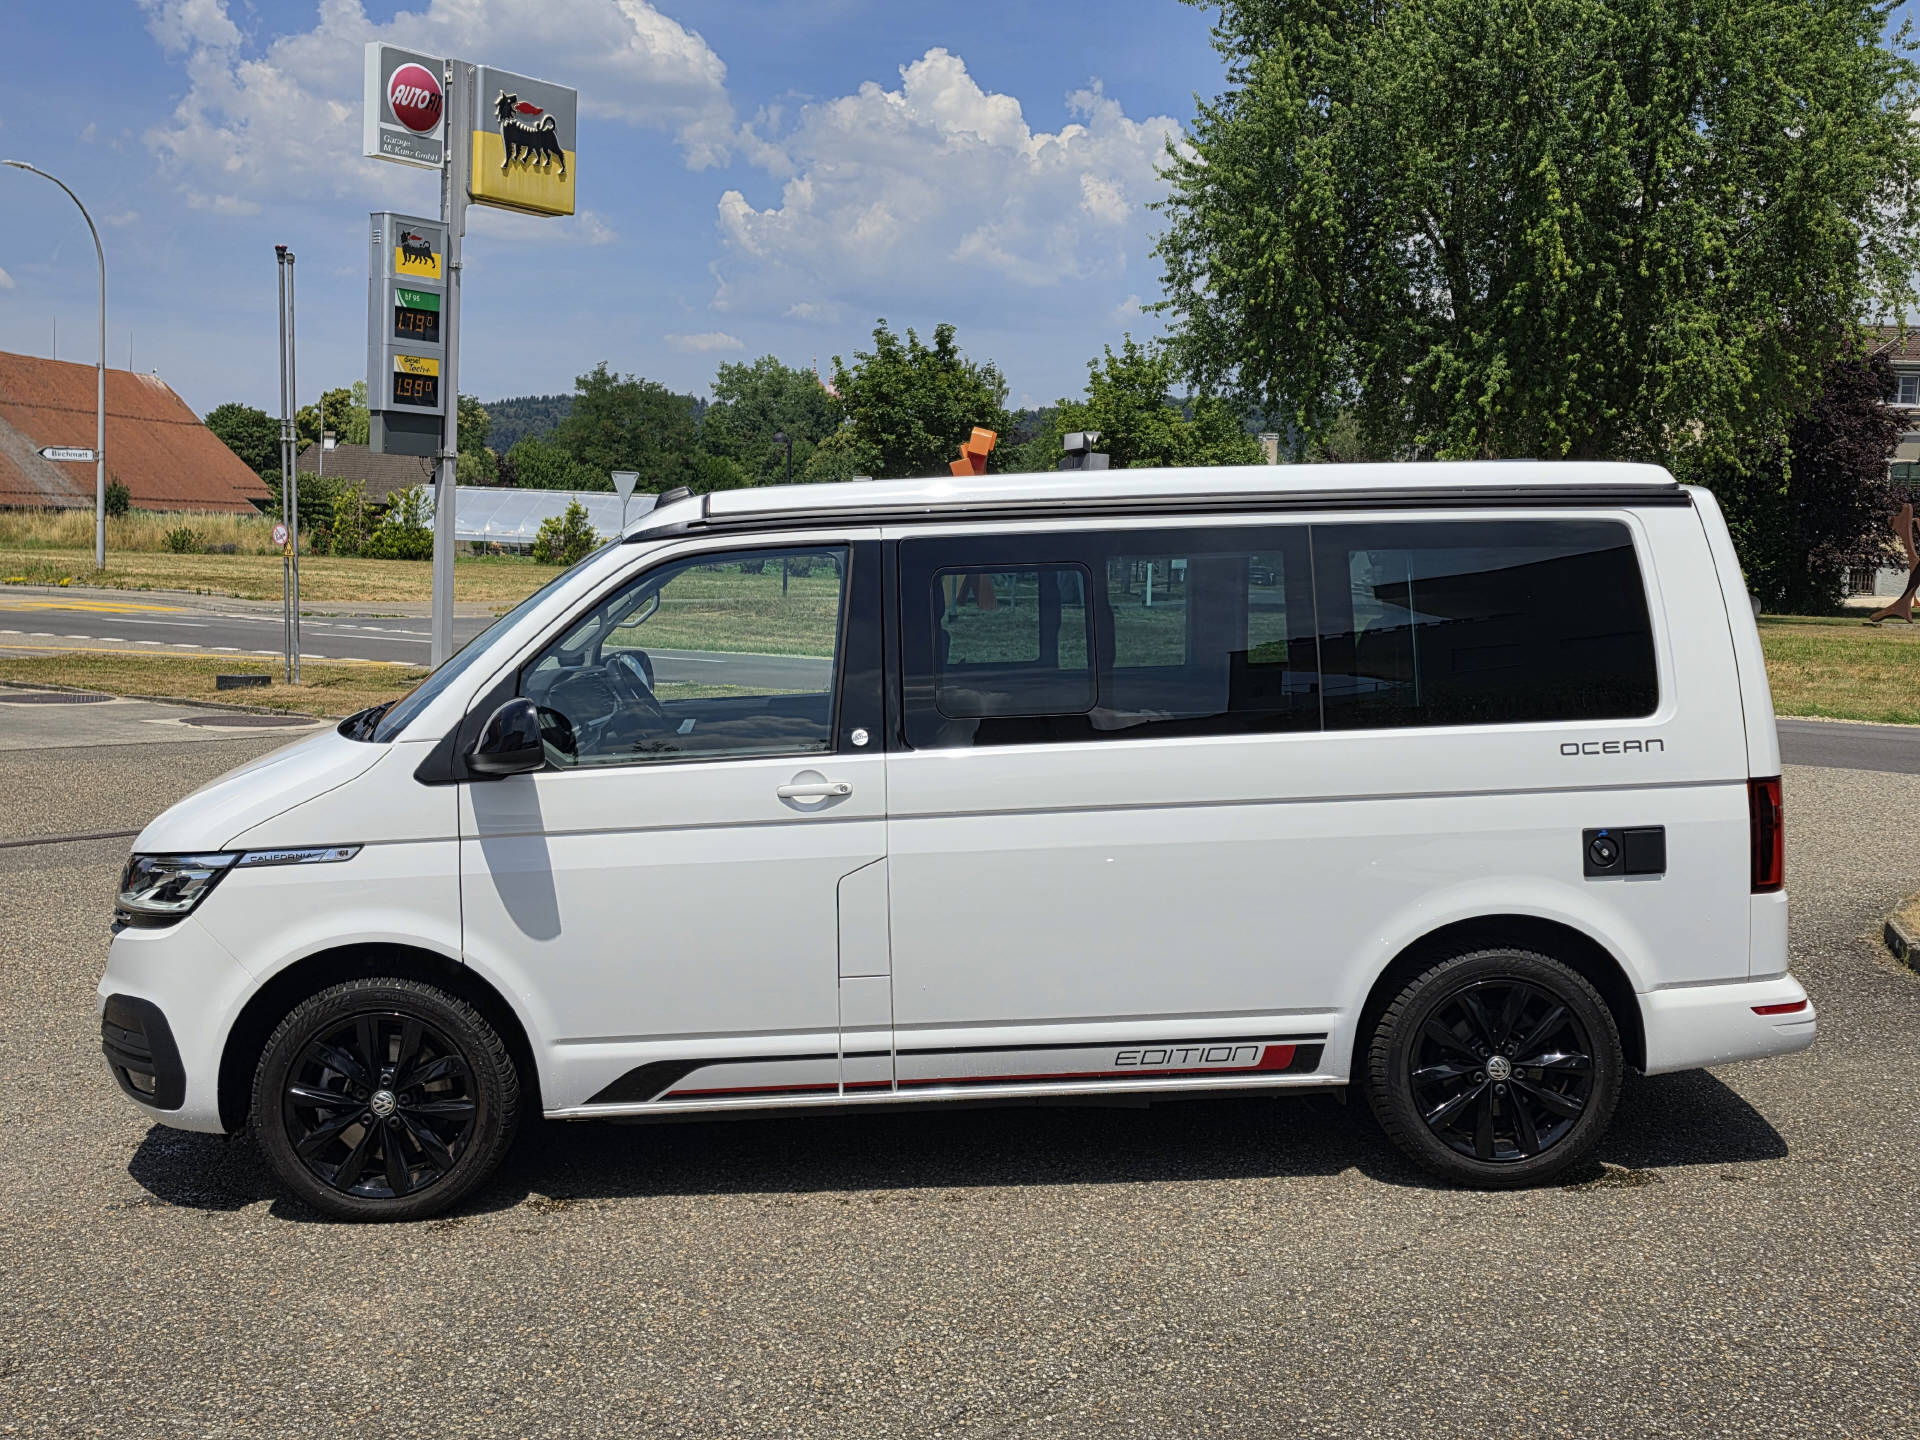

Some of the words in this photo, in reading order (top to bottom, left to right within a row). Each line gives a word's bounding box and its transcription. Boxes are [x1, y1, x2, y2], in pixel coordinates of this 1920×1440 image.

[383, 134, 411, 147] Garage
[415, 150, 439, 162] GmbH
[1560, 738, 1665, 756] OCEAN
[250, 852, 313, 862] CALIFORNIA
[1114, 1045, 1259, 1066] EDITION
